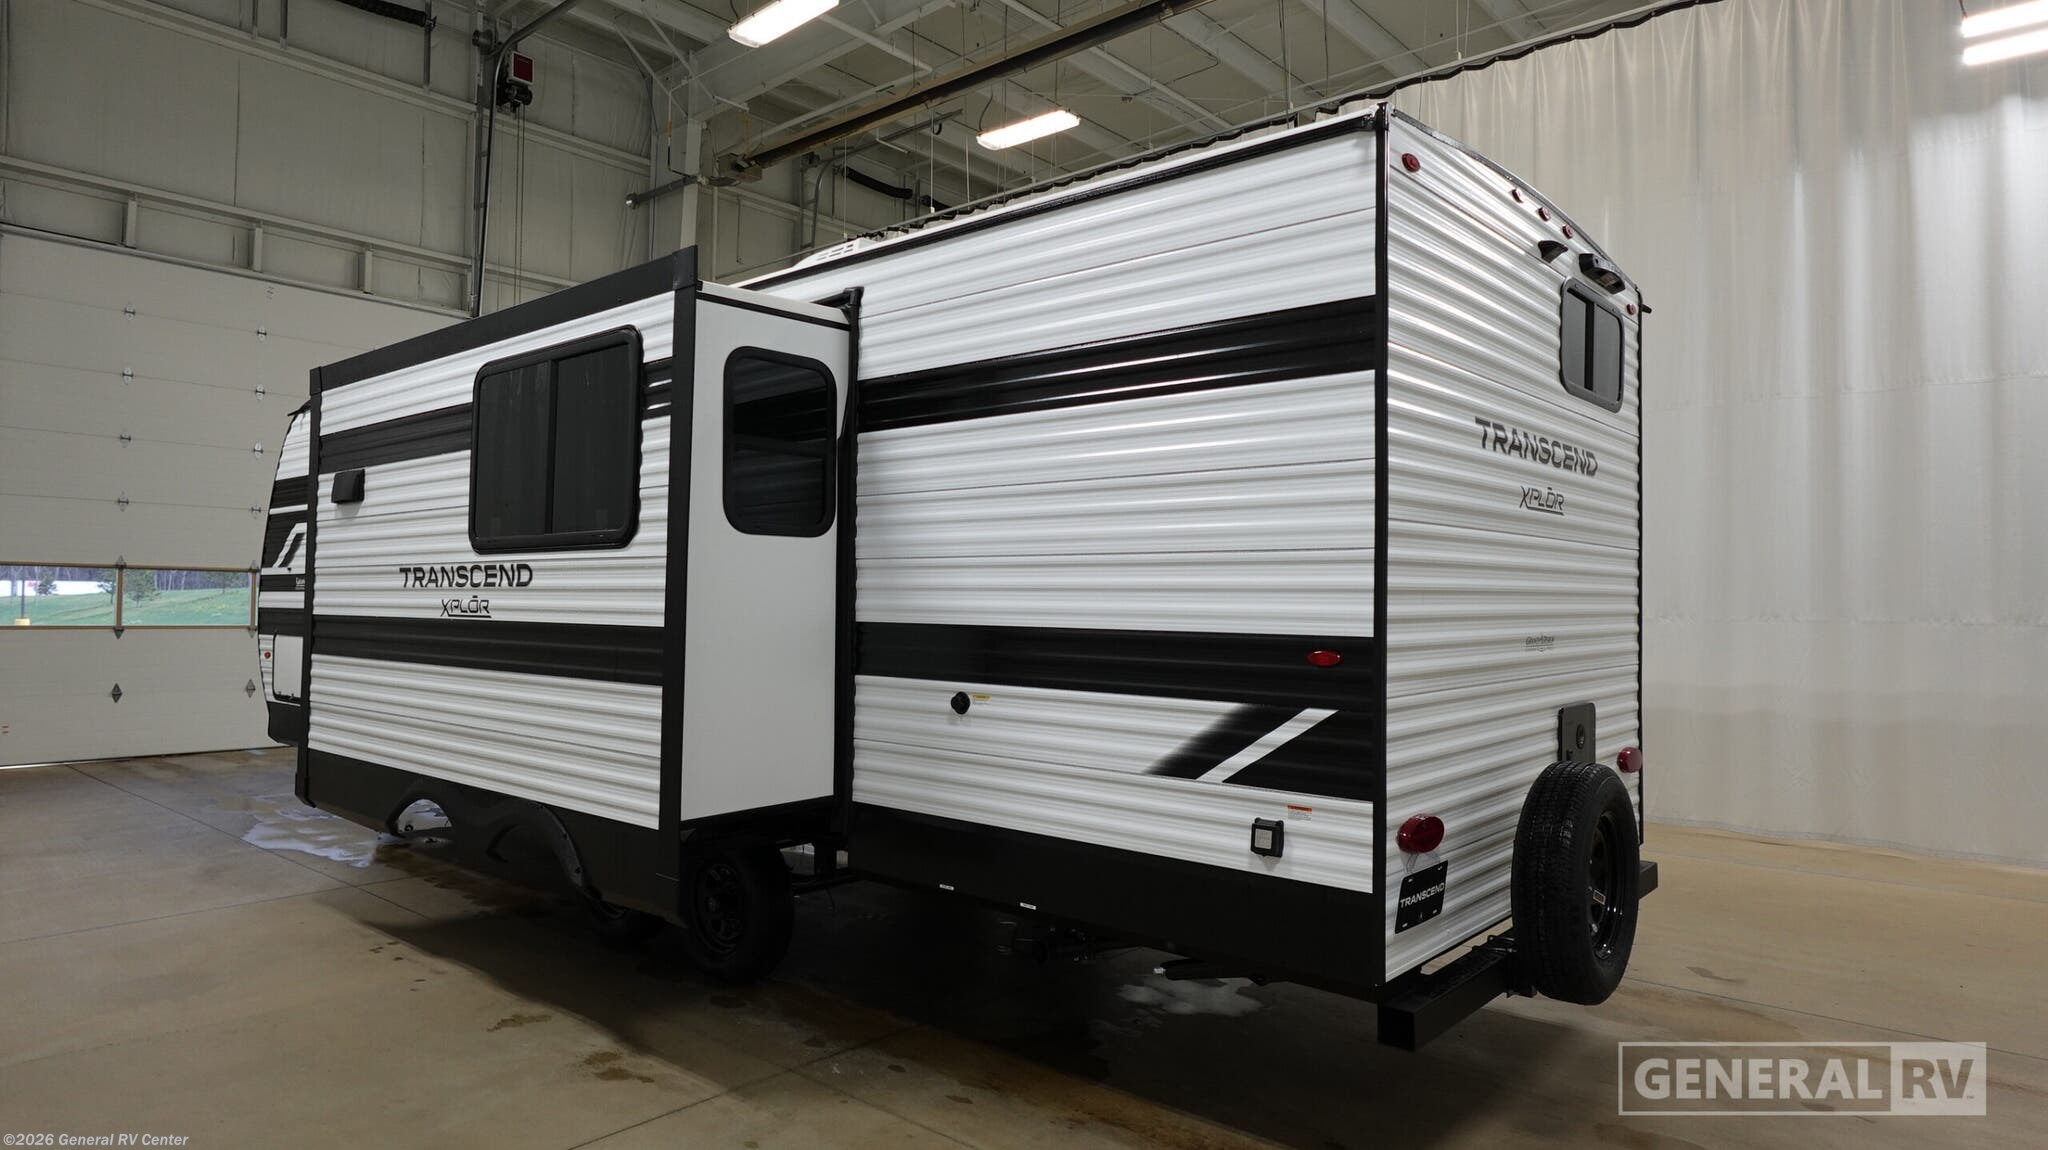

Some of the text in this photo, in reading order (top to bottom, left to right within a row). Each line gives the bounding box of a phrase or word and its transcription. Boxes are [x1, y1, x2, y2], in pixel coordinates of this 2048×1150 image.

[1475, 416, 1599, 477] TRANSCEND
[399, 563, 534, 588] TRANSCEND
[1399, 882, 1445, 909] TRANSCEND
